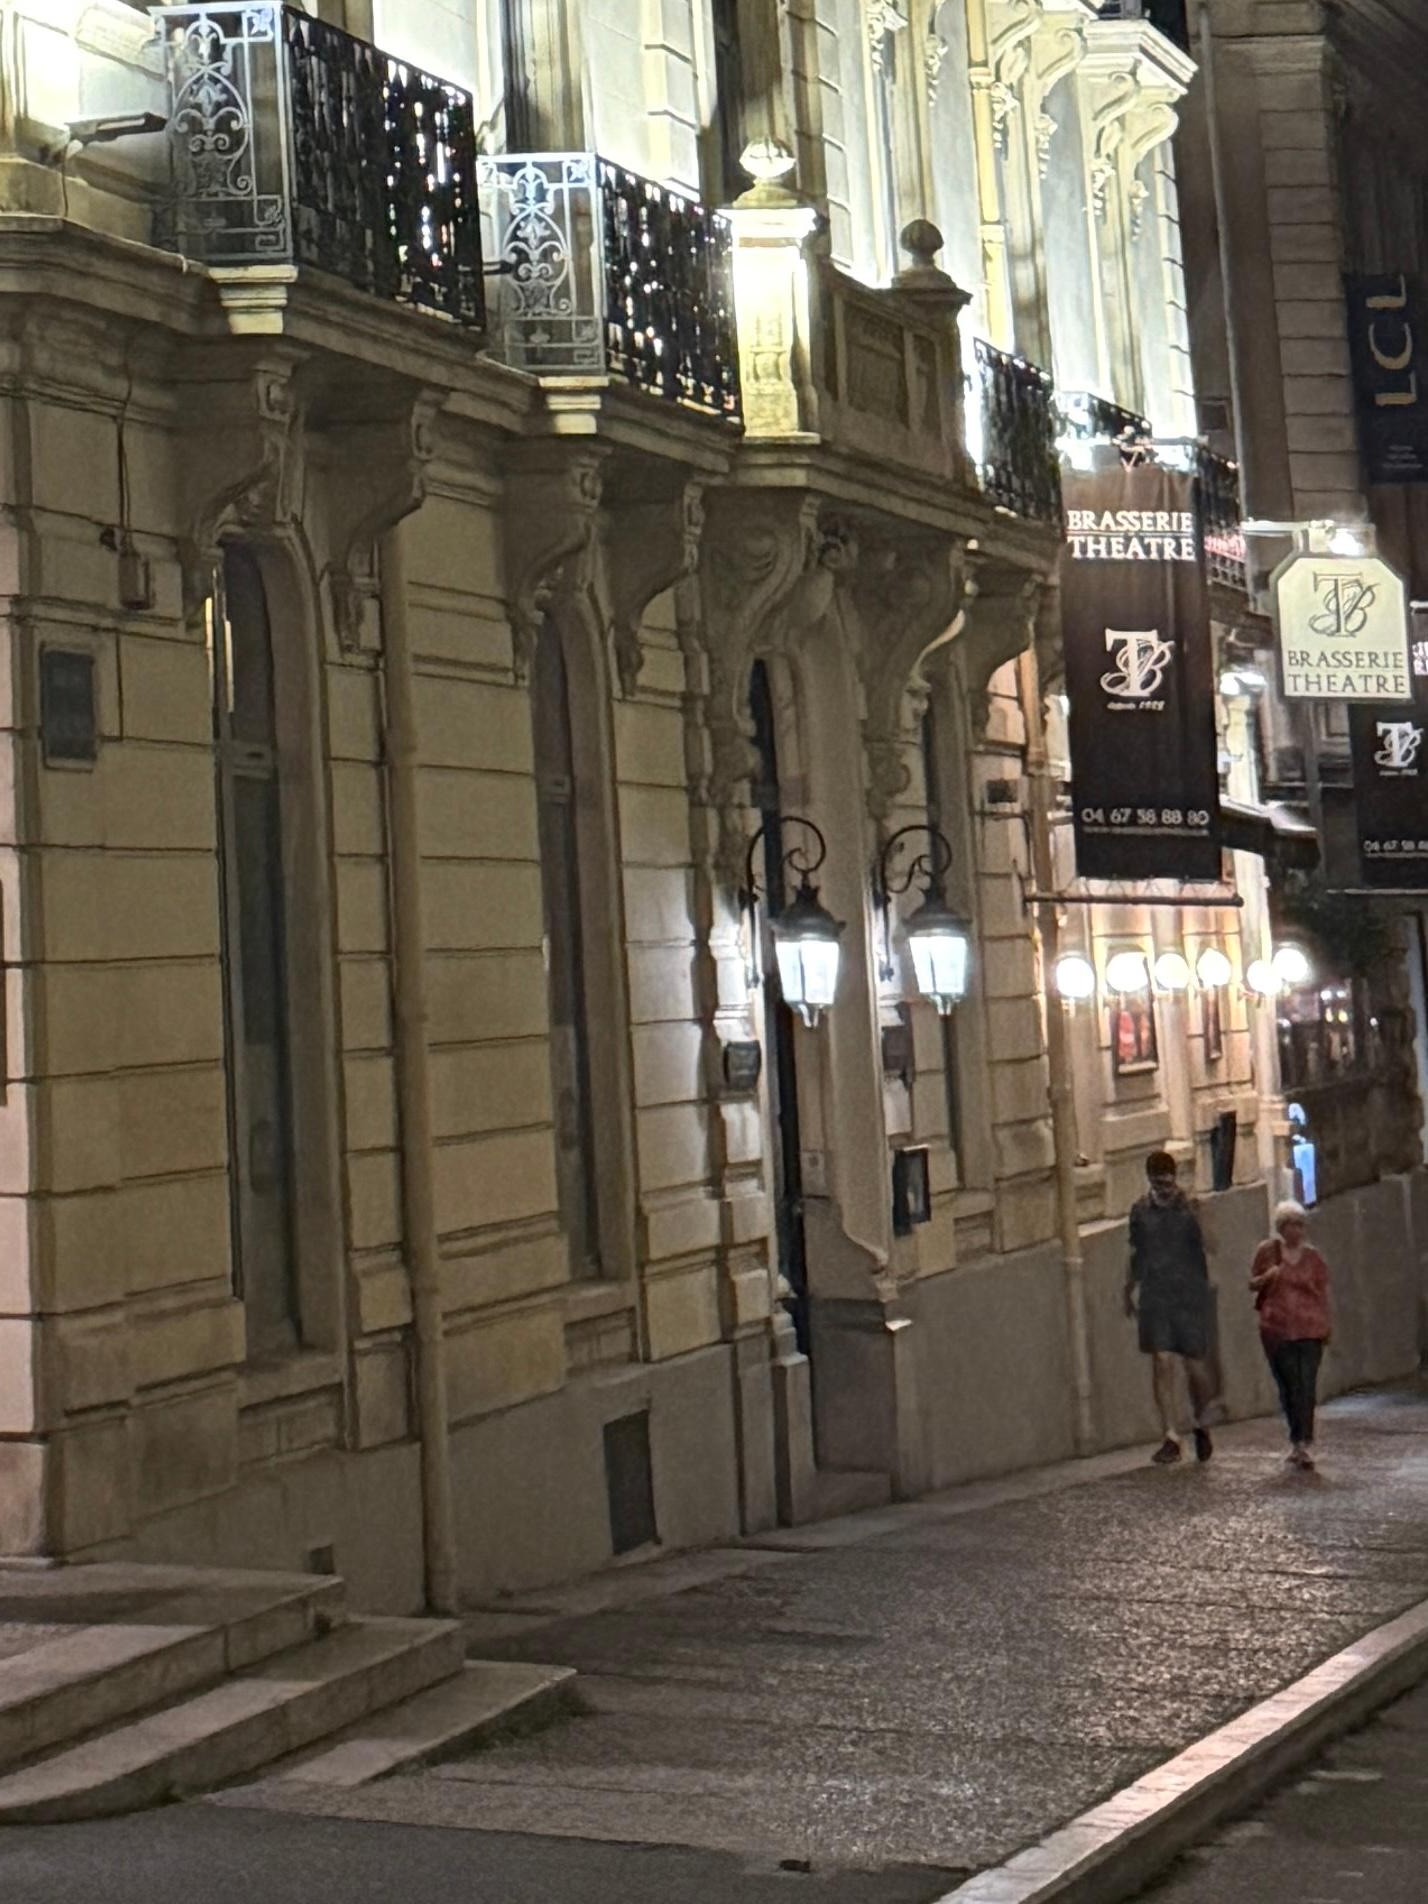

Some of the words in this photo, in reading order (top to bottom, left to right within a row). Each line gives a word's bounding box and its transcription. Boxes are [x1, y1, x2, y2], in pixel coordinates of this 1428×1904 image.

[1067, 510, 1193, 532] BRASSERIE
[1288, 650, 1404, 669] BRASSERIE
[1081, 807, 1105, 824] 04
[1110, 807, 1132, 824] 67
[1161, 808, 1183, 825] 88
[1187, 809, 1210, 826] 80
